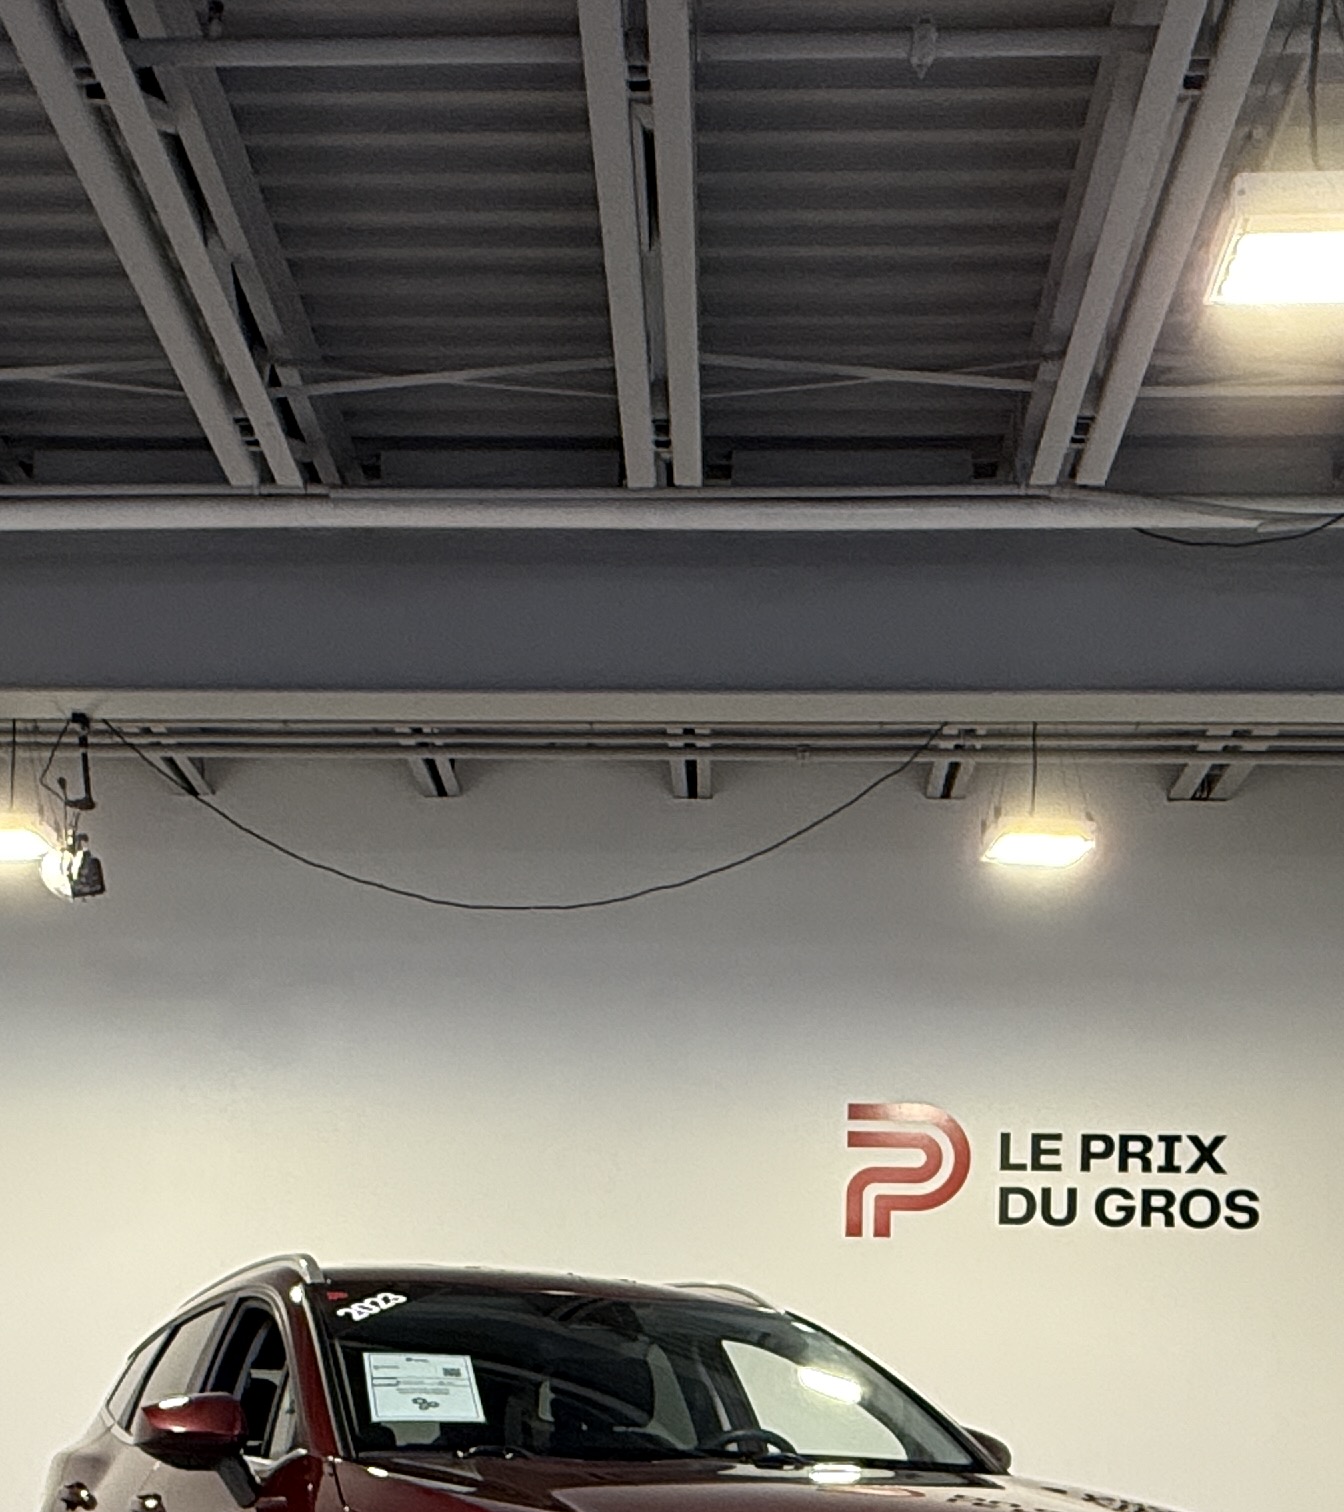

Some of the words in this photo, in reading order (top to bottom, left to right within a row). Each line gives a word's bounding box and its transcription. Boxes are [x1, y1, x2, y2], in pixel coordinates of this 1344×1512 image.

[999, 1131, 1063, 1172] LE
[1080, 1133, 1228, 1175] PRIX
[998, 1186, 1078, 1227] DU
[1094, 1187, 1260, 1230] GROS
